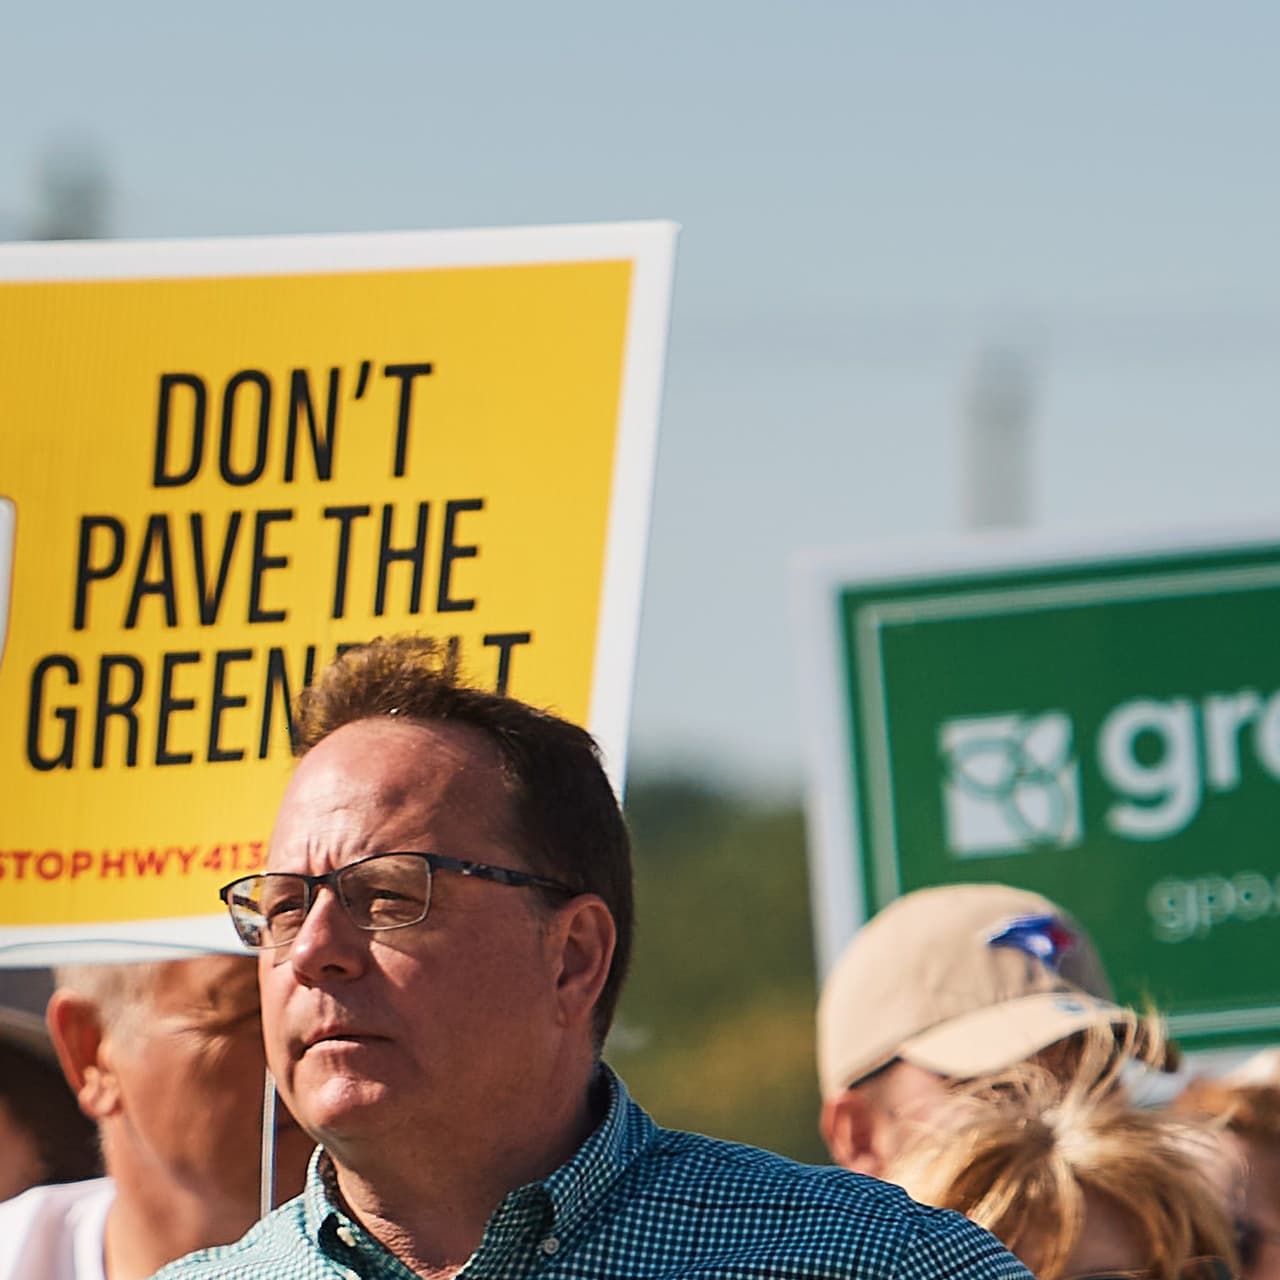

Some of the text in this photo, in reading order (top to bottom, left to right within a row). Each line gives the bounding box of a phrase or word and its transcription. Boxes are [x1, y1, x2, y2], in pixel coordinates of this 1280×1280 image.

[154, 361, 433, 488] DON'T
[73, 499, 485, 631] PAVE THE
[27, 632, 532, 772] GREENT
